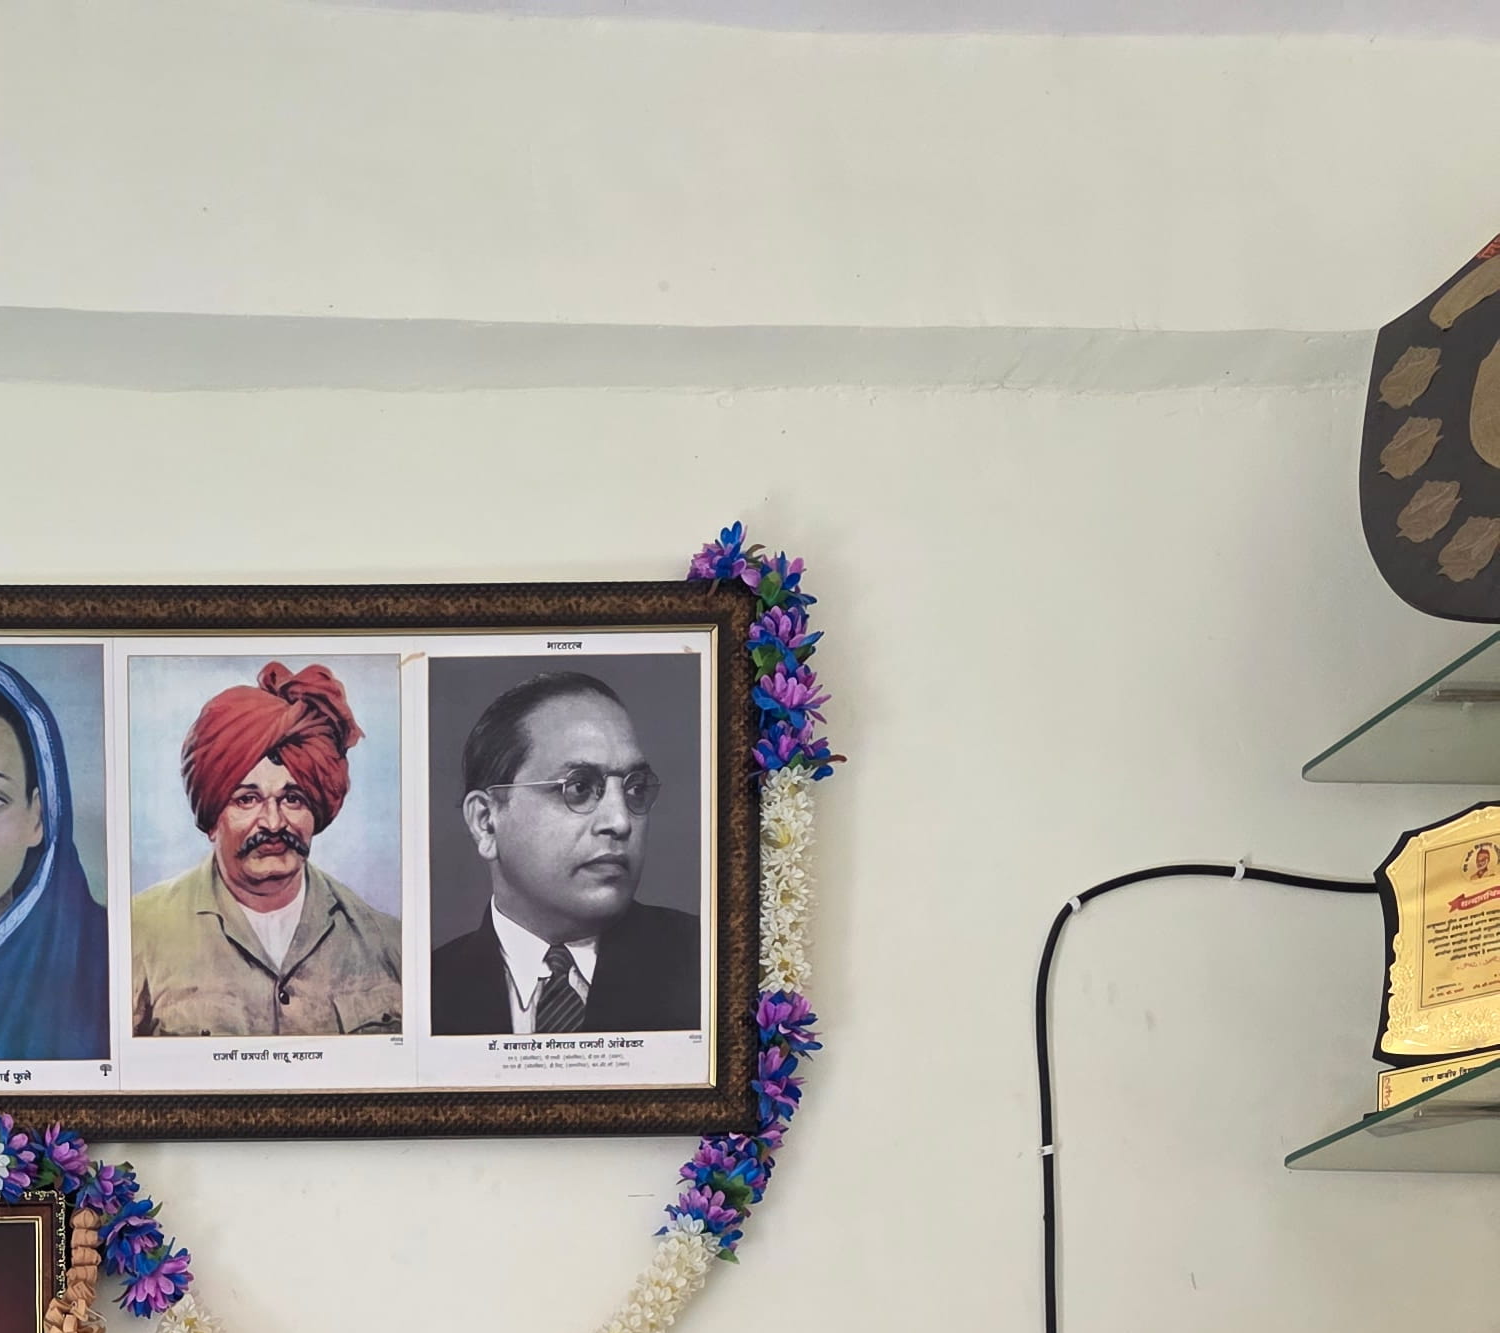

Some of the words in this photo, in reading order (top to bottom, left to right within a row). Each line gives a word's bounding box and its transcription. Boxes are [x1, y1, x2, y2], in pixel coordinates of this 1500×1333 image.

[503, 1039, 542, 1051] बाबासाहेब
[546, 1039, 575, 1050] भीमराव
[579, 1038, 604, 1049] रामजी
[608, 1038, 644, 1048] आंबेडकर
[241, 1050, 269, 1061] छत्रपती
[273, 1052, 291, 1063] शाहू
[292, 1052, 323, 1061] महाराज
[13, 1070, 31, 1084] फुले
